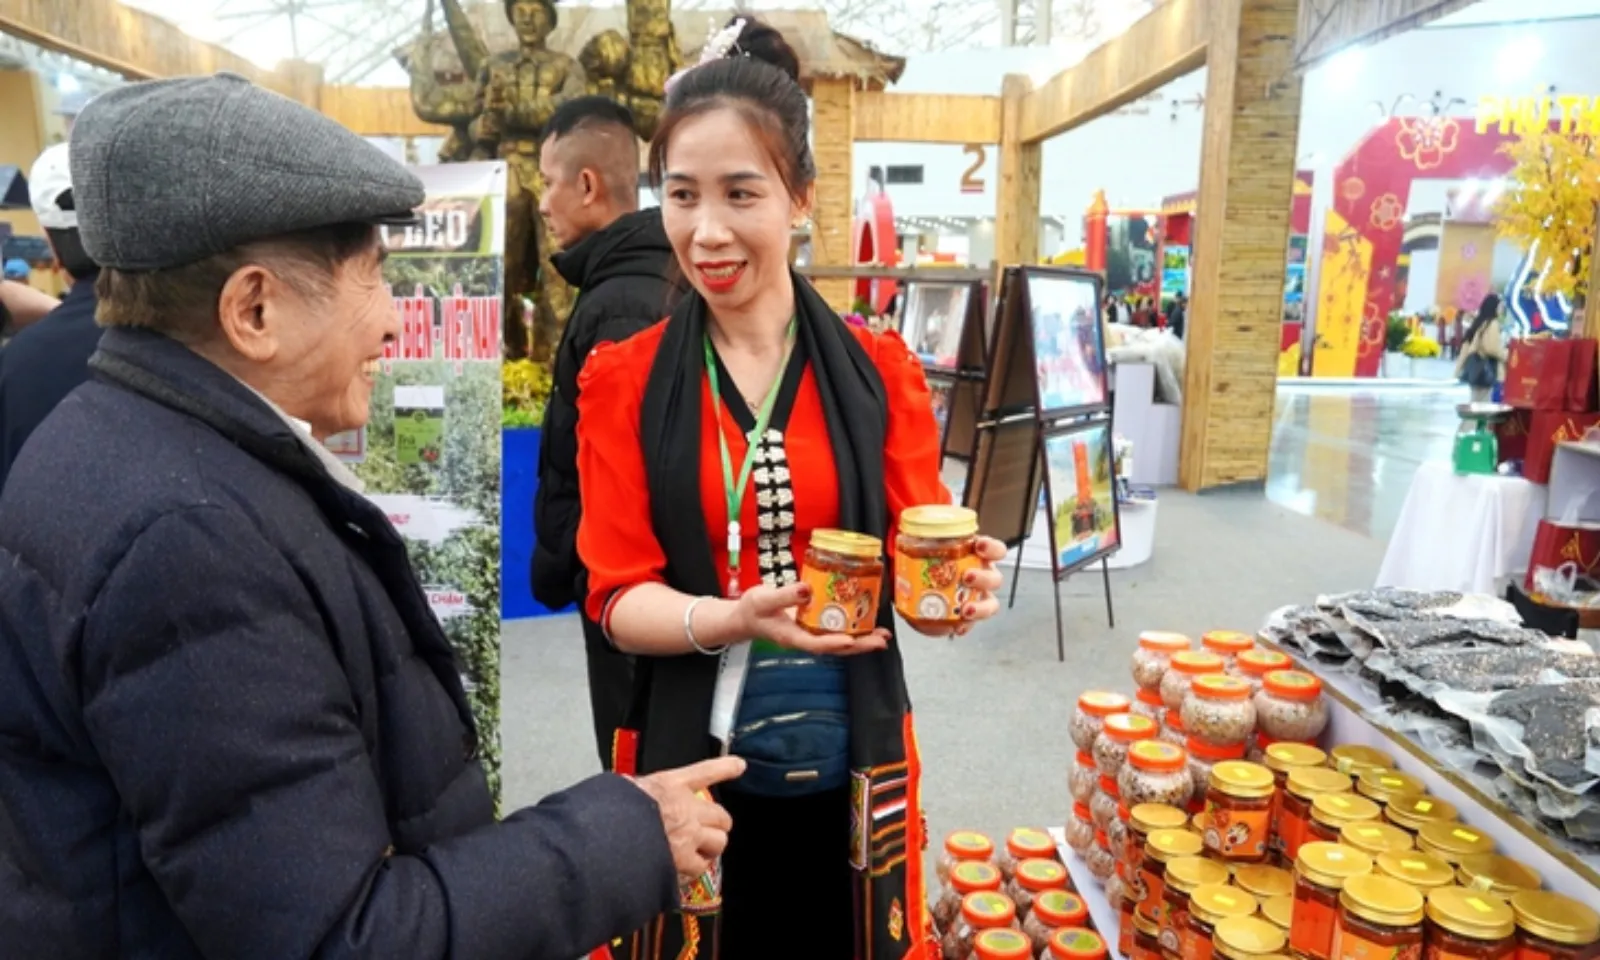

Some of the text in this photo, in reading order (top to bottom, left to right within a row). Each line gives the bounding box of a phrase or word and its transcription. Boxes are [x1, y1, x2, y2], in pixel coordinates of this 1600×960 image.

[1475, 83, 1550, 136] PHÚ
[961, 142, 985, 187] 2
[471, 296, 500, 360] NAM
